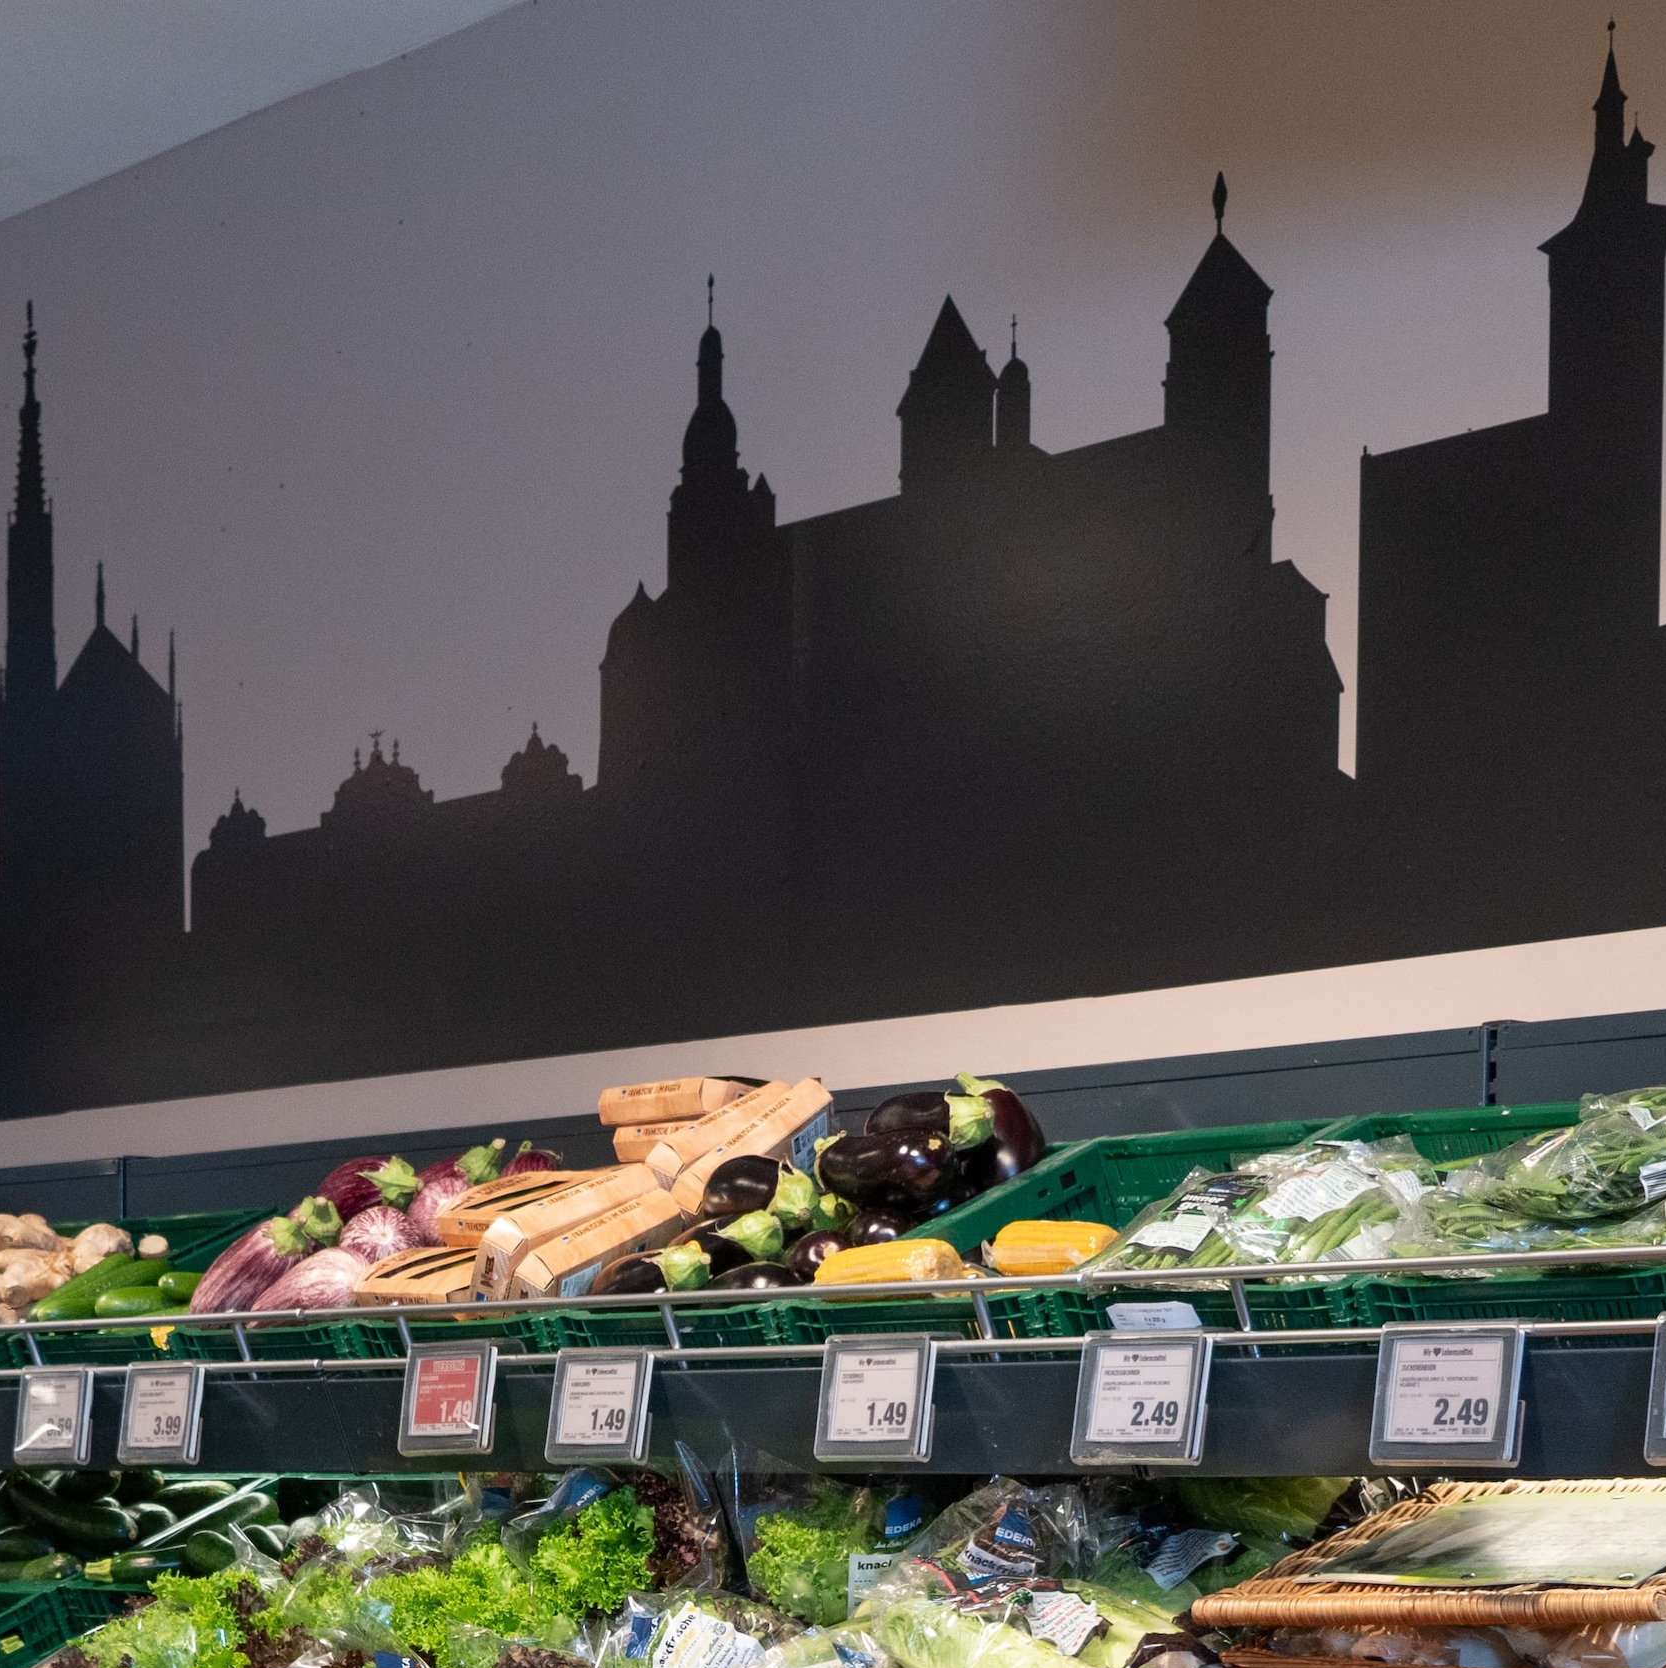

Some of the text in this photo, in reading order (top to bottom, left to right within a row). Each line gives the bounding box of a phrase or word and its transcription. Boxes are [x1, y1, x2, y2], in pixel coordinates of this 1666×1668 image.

[439, 1400, 472, 1424] 1.49
[591, 1408, 626, 1431] 1.49
[866, 1401, 907, 1427] 1.49
[1130, 1400, 1179, 1427] 2.49
[1432, 1397, 1489, 1426] 2.49
[153, 1415, 181, 1436] 3.99
[884, 1516, 923, 1535] EDEKA
